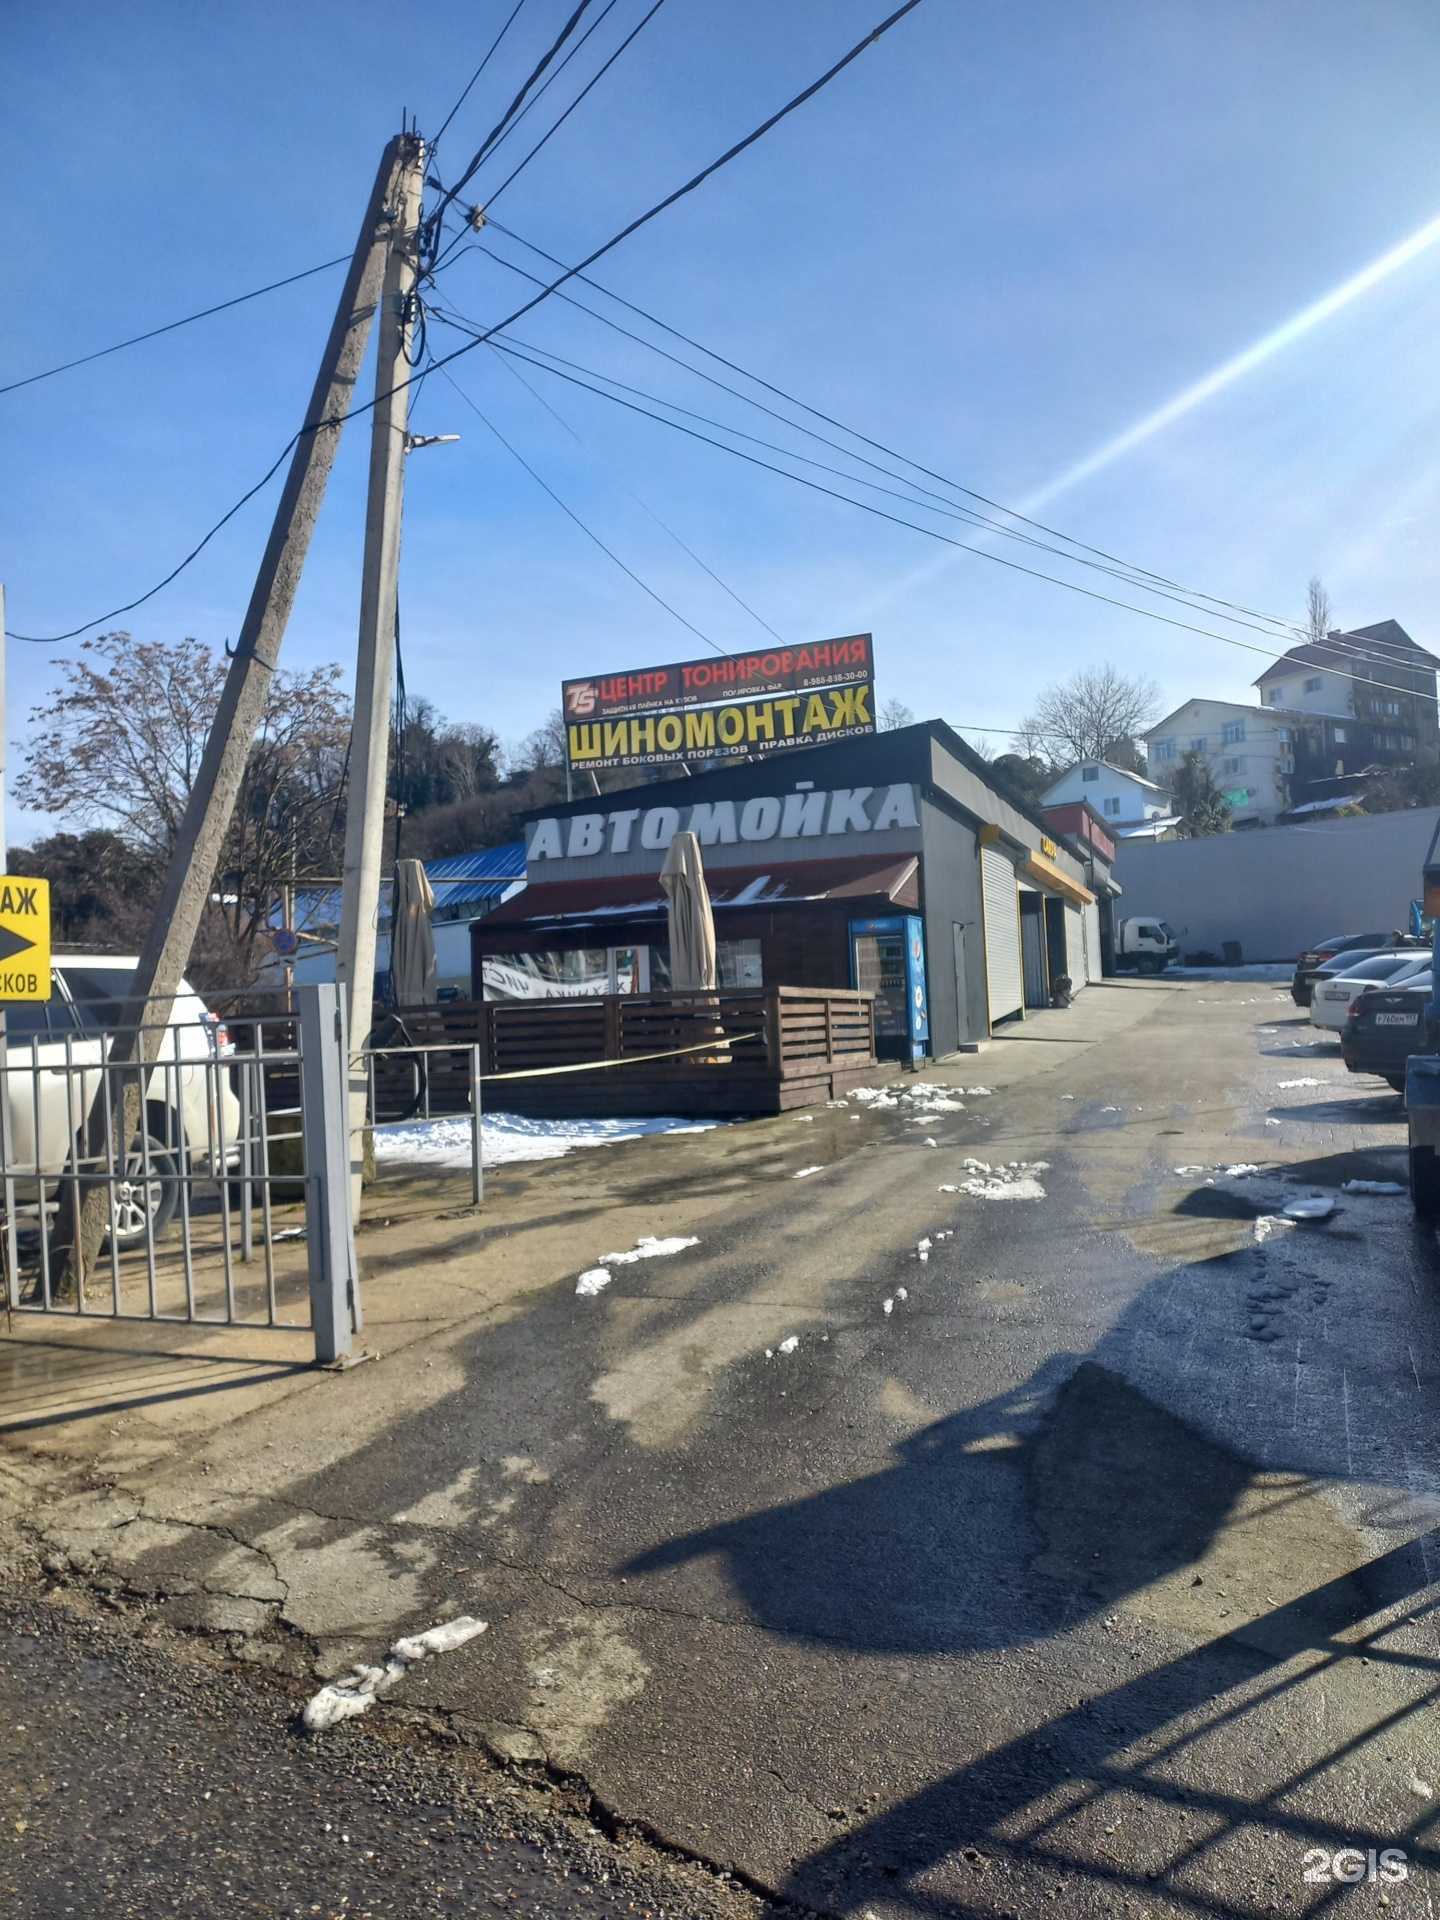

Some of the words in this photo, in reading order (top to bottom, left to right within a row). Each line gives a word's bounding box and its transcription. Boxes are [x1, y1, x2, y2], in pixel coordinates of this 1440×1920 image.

[600, 671, 669, 702] ЦЕНТР
[681, 638, 867, 689] ТОНИРОВАНИЯ
[569, 685, 871, 760] ШИНОМОНТАЖ
[571, 757, 619, 770] РЕМОНТ
[622, 752, 684, 765] БОКОВЫХ
[687, 744, 749, 760] ПОРЕЗОВ
[759, 734, 814, 751] ПРАВКА
[816, 725, 874, 743] ДИСКОВ
[526, 782, 919, 862] АВТОМОЙКА
[0, 973, 38, 993] КОВ
